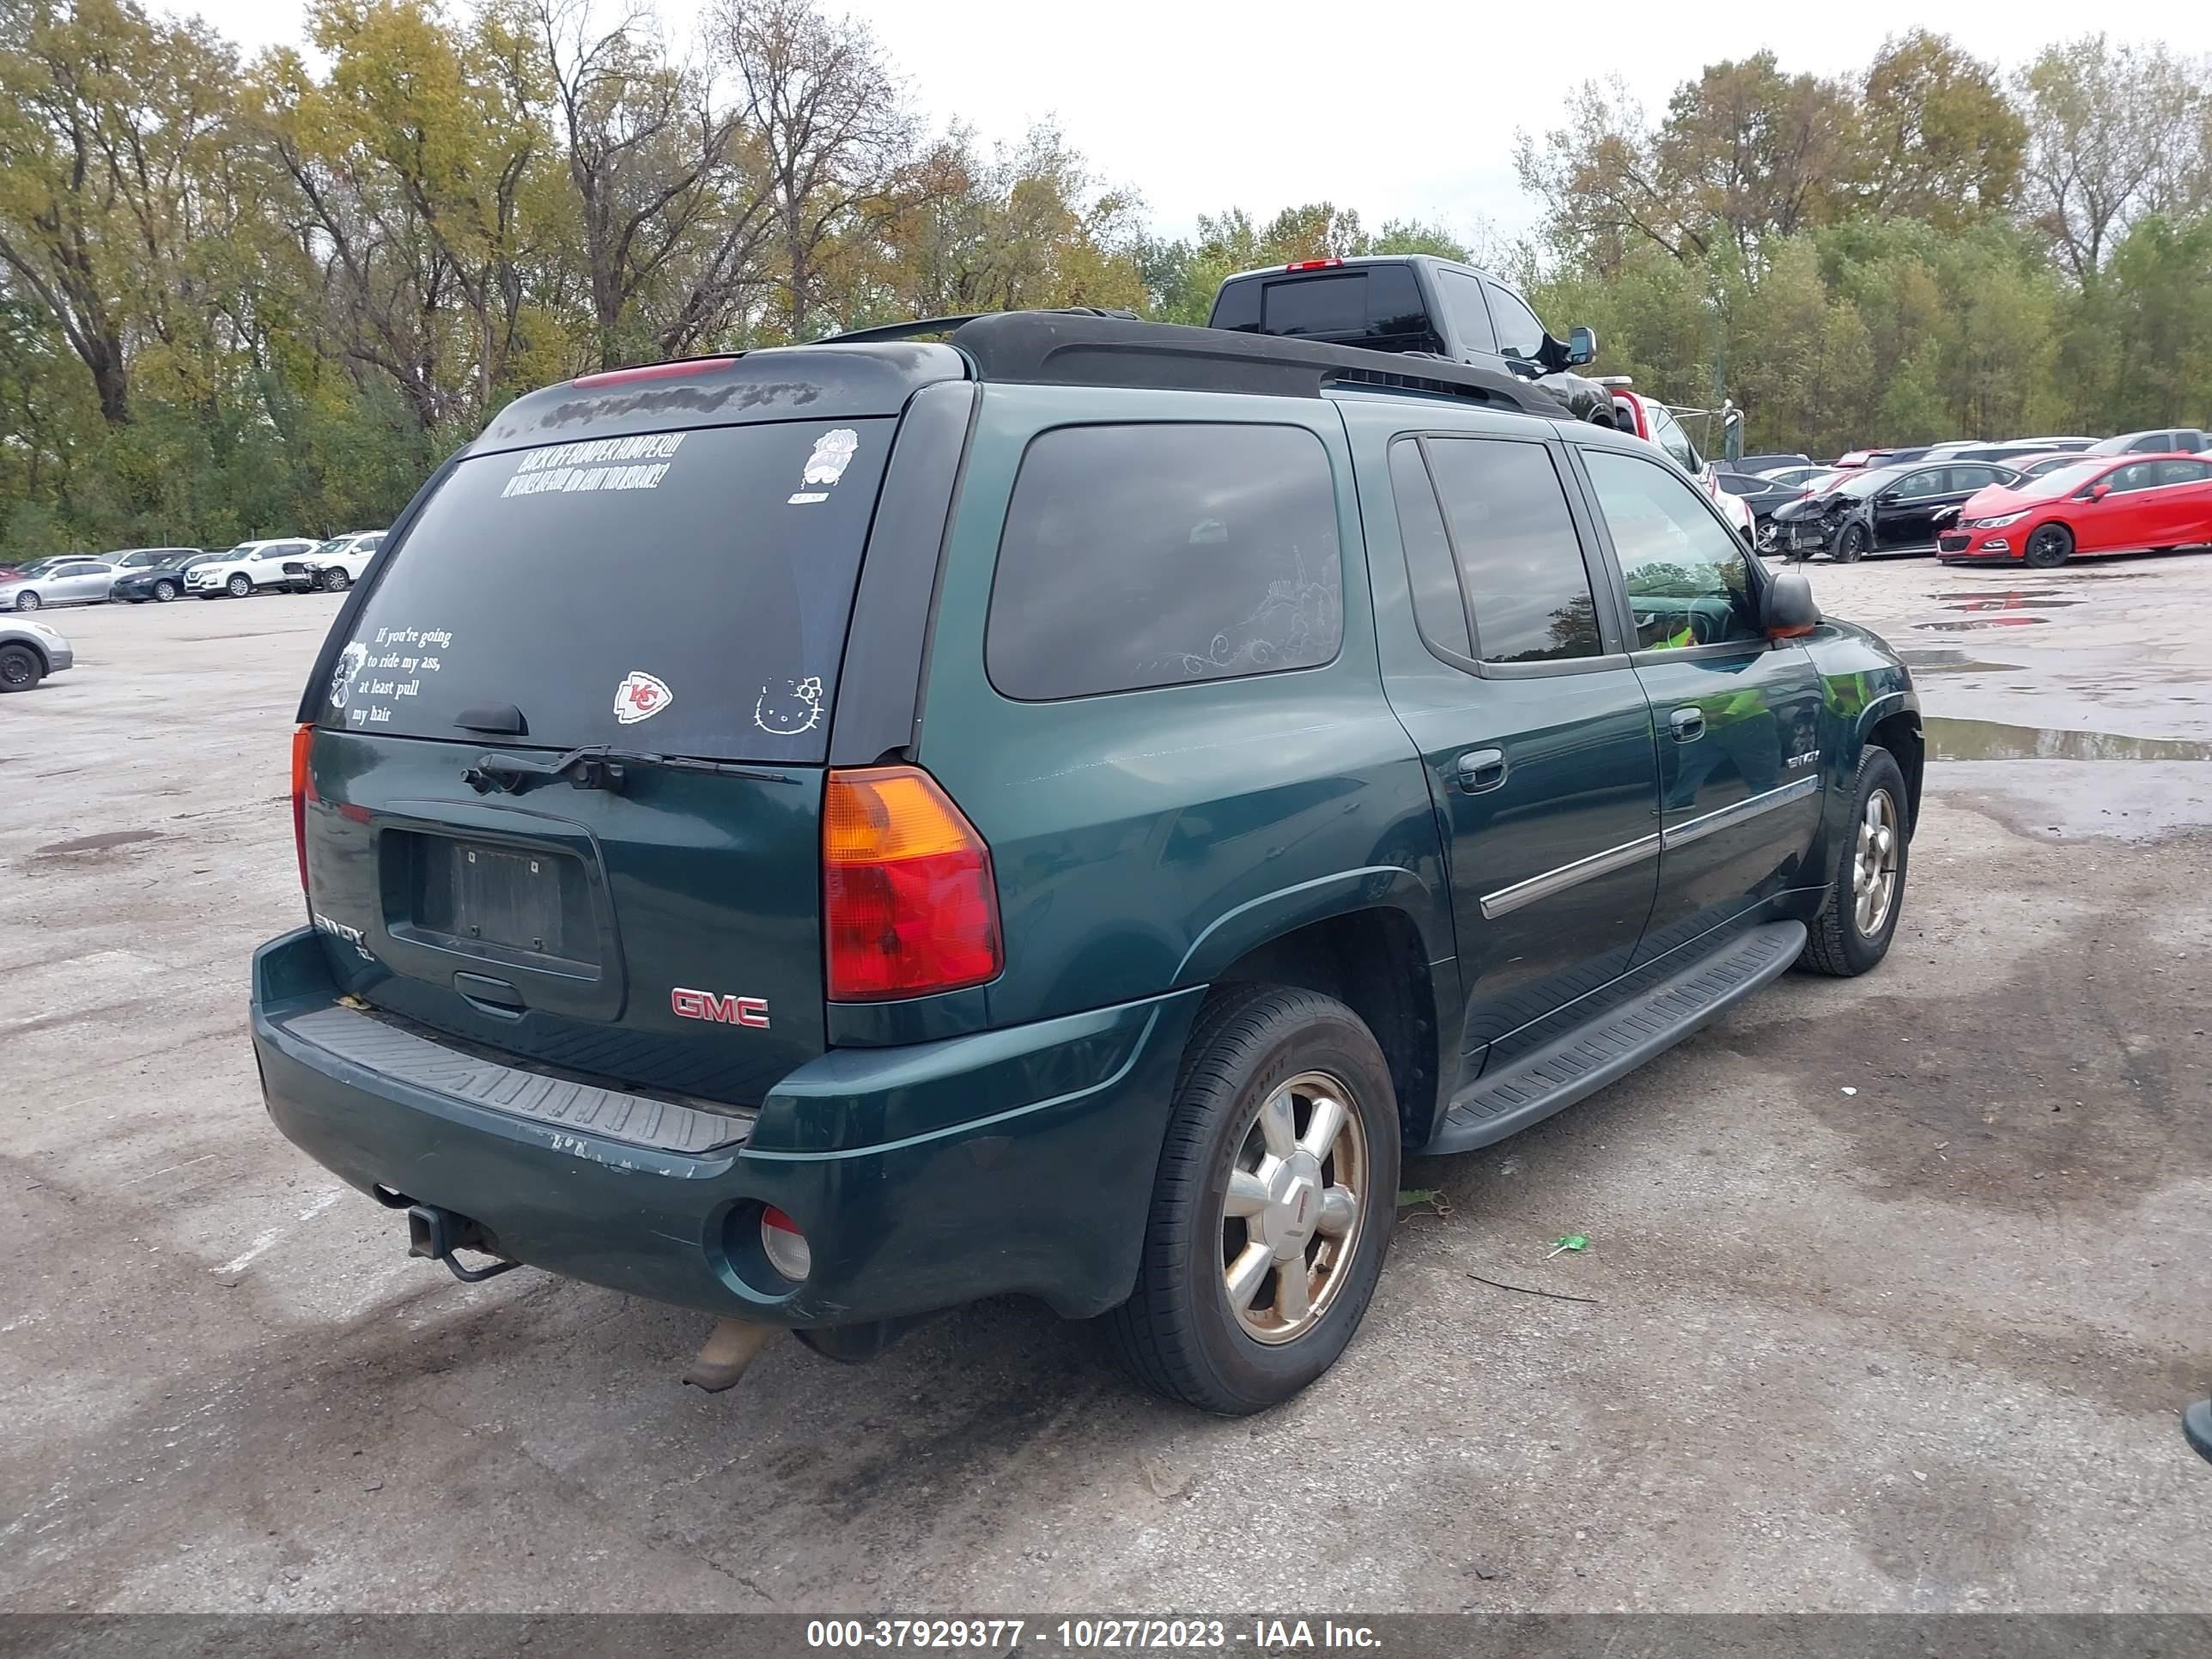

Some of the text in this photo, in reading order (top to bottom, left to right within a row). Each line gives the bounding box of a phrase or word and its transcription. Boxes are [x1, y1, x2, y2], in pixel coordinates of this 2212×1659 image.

[517, 447, 556, 473] BACK
[546, 443, 578, 467] OFF
[375, 626, 453, 649] If you're going
[367, 653, 441, 673] to ride my ass,
[358, 678, 420, 700] at least pull
[352, 705, 392, 726] my hair
[672, 988, 771, 1030] GMC
